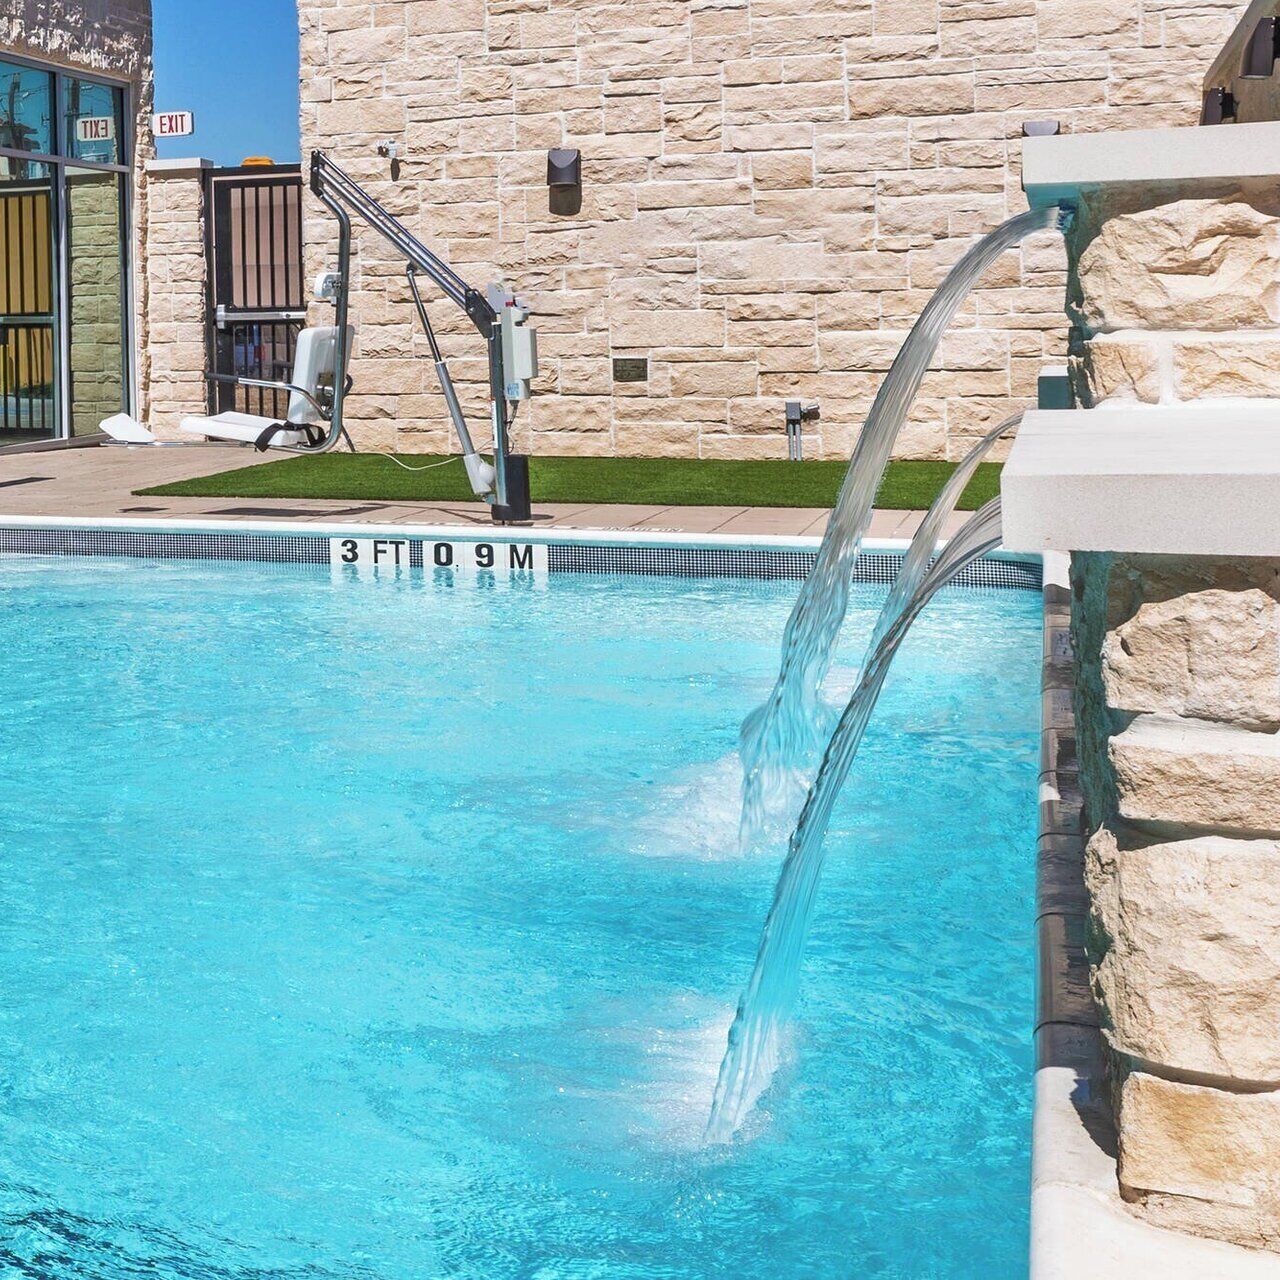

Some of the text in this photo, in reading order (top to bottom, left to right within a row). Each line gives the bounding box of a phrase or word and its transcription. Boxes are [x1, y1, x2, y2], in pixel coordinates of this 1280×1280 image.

[159, 114, 186, 134] EXIT
[340, 539, 359, 563] 3
[373, 540, 406, 564] FT
[509, 544, 534, 569] M
